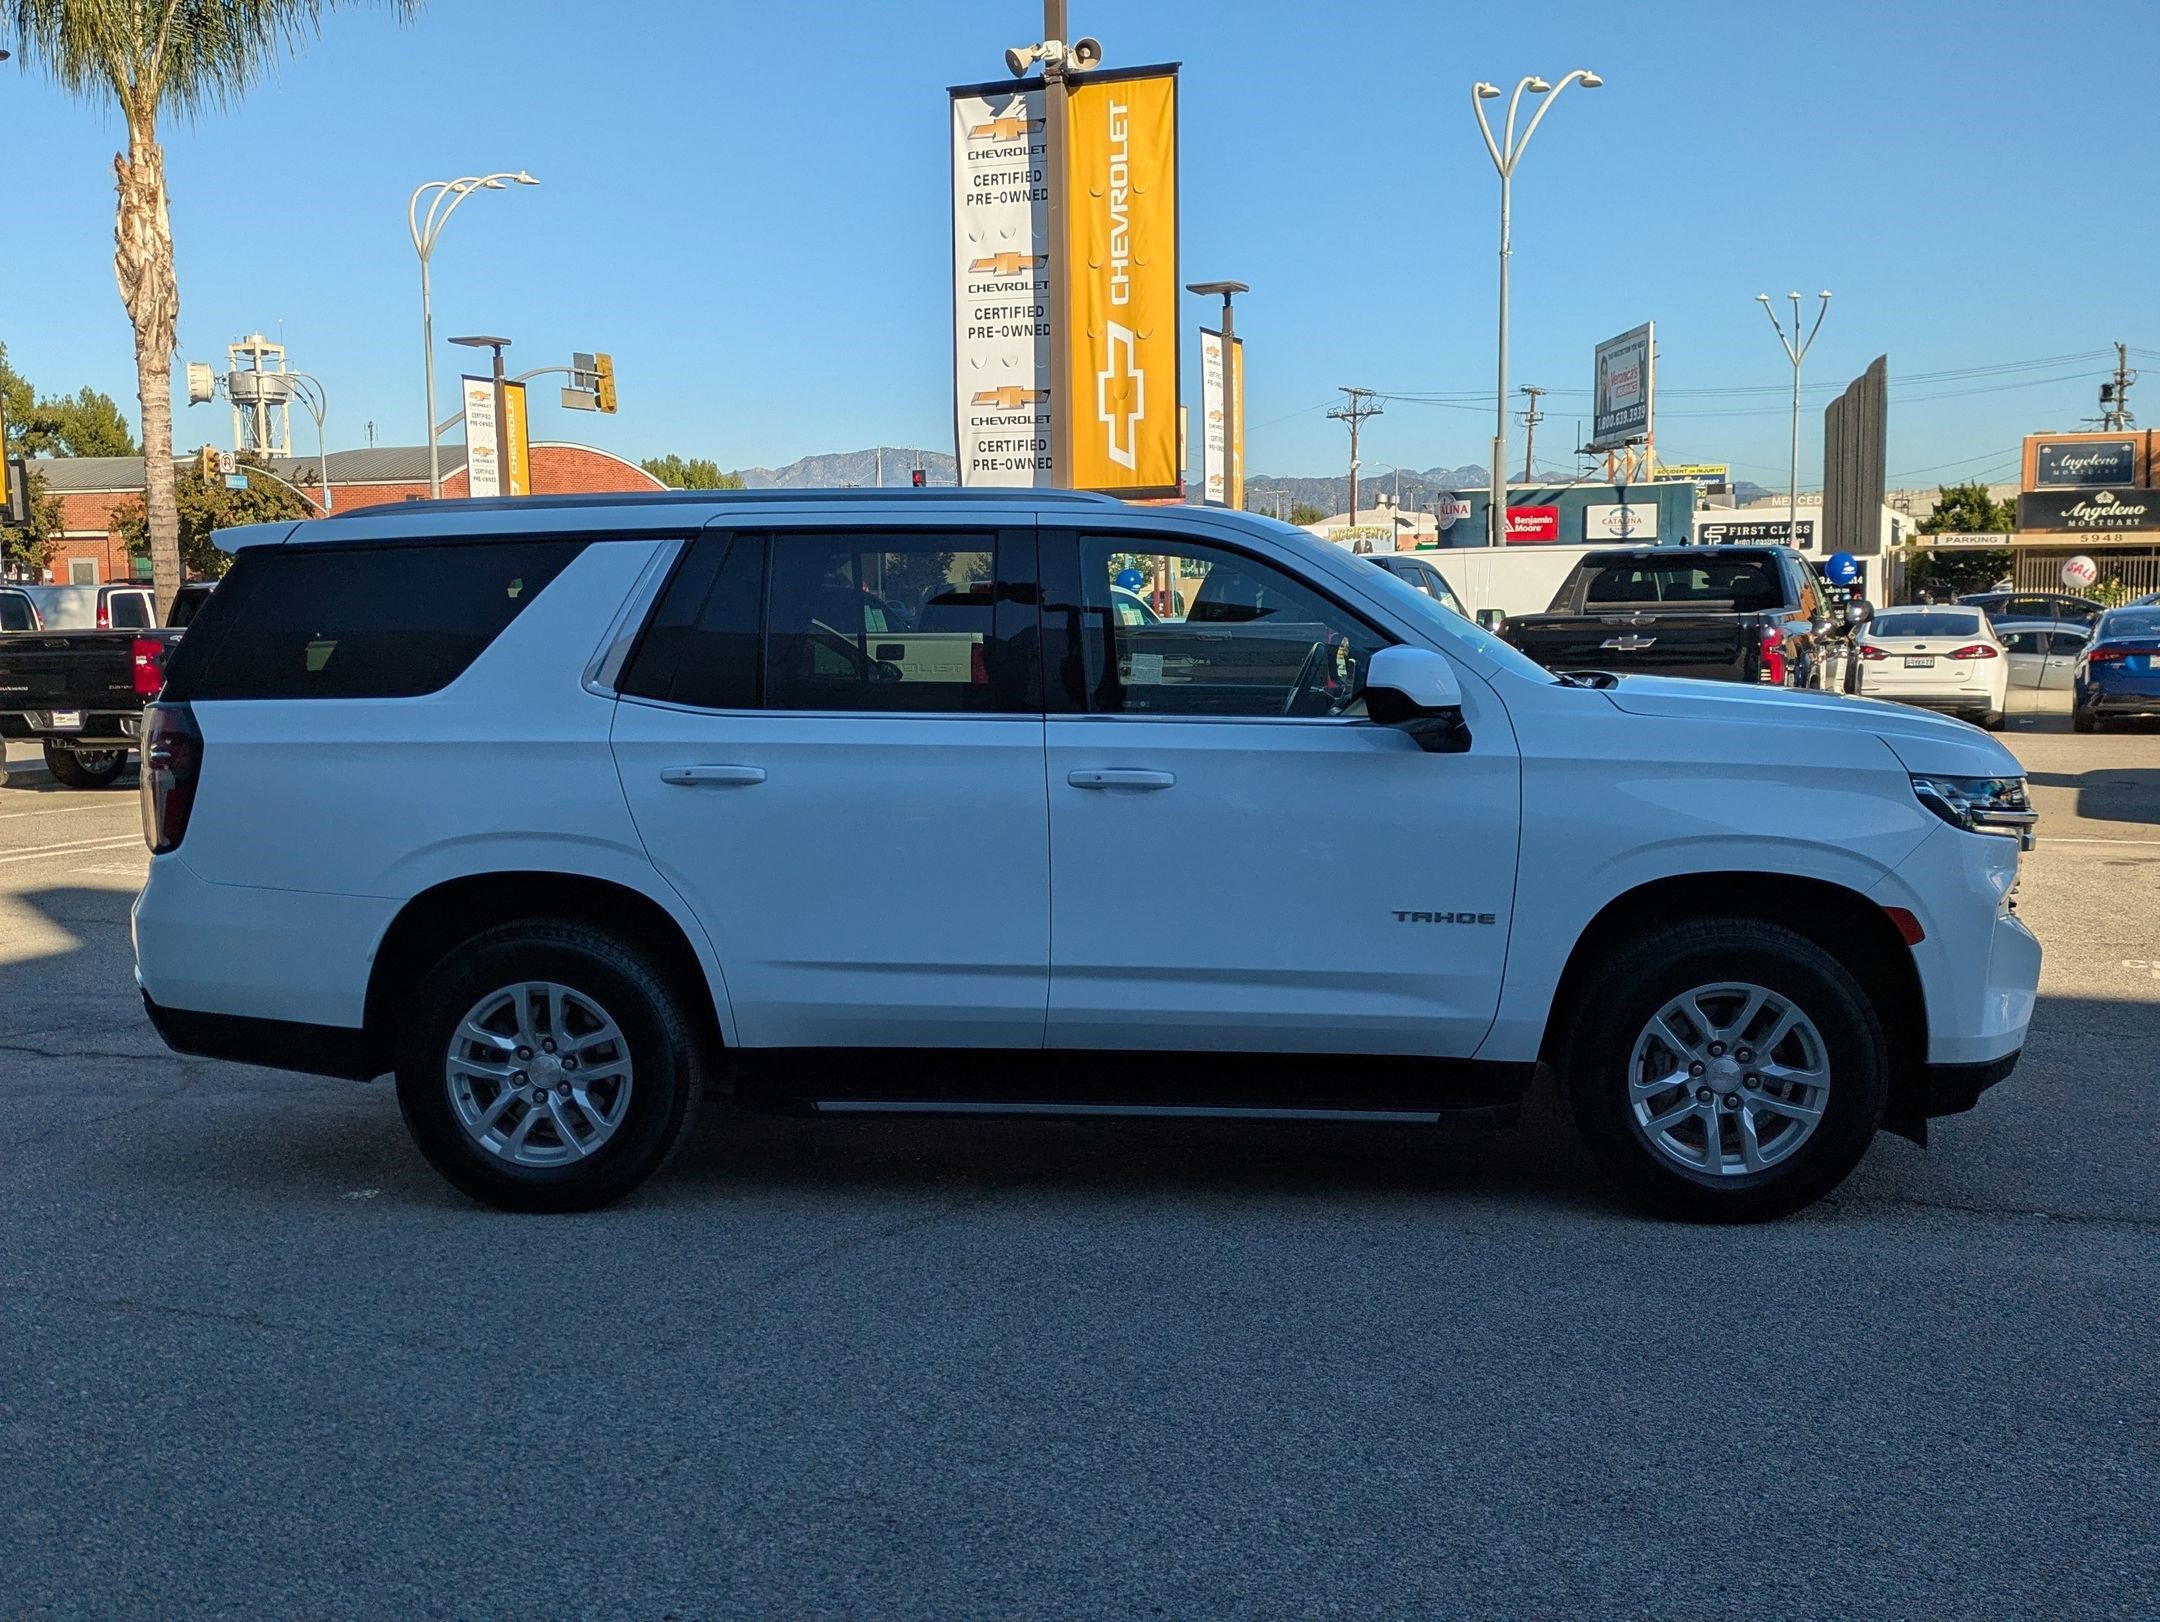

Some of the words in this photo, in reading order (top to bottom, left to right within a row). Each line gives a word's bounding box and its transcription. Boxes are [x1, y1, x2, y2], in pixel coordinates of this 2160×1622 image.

[967, 144, 1047, 161] CHEVROLET
[973, 169, 1042, 187] CERTIFIED
[966, 188, 1048, 206] PRE-OWNED
[1109, 99, 1130, 305] CHEVROLET
[968, 280, 1050, 294] CHEVROLET
[974, 305, 1045, 321] CERTIFIED
[968, 323, 1051, 339] PRE-OWNED
[970, 414, 1051, 426] CHEVROLET
[977, 439, 1047, 453] CERTIFIED
[973, 457, 1052, 471] PRE-OWNED
[2051, 452, 2119, 471] Angeleno
[1772, 495, 1823, 506] MECED
[2061, 500, 2148, 521] Angeleno
[1514, 515, 1553, 525] Benjamin
[2068, 518, 2140, 527] MORTUARY
[1515, 524, 1543, 532] Moore
[1729, 526, 1766, 536] FIRST
[2080, 534, 2123, 543] 5948
[2066, 561, 2097, 581] SALE
[1391, 910, 1497, 925] TAHOE
